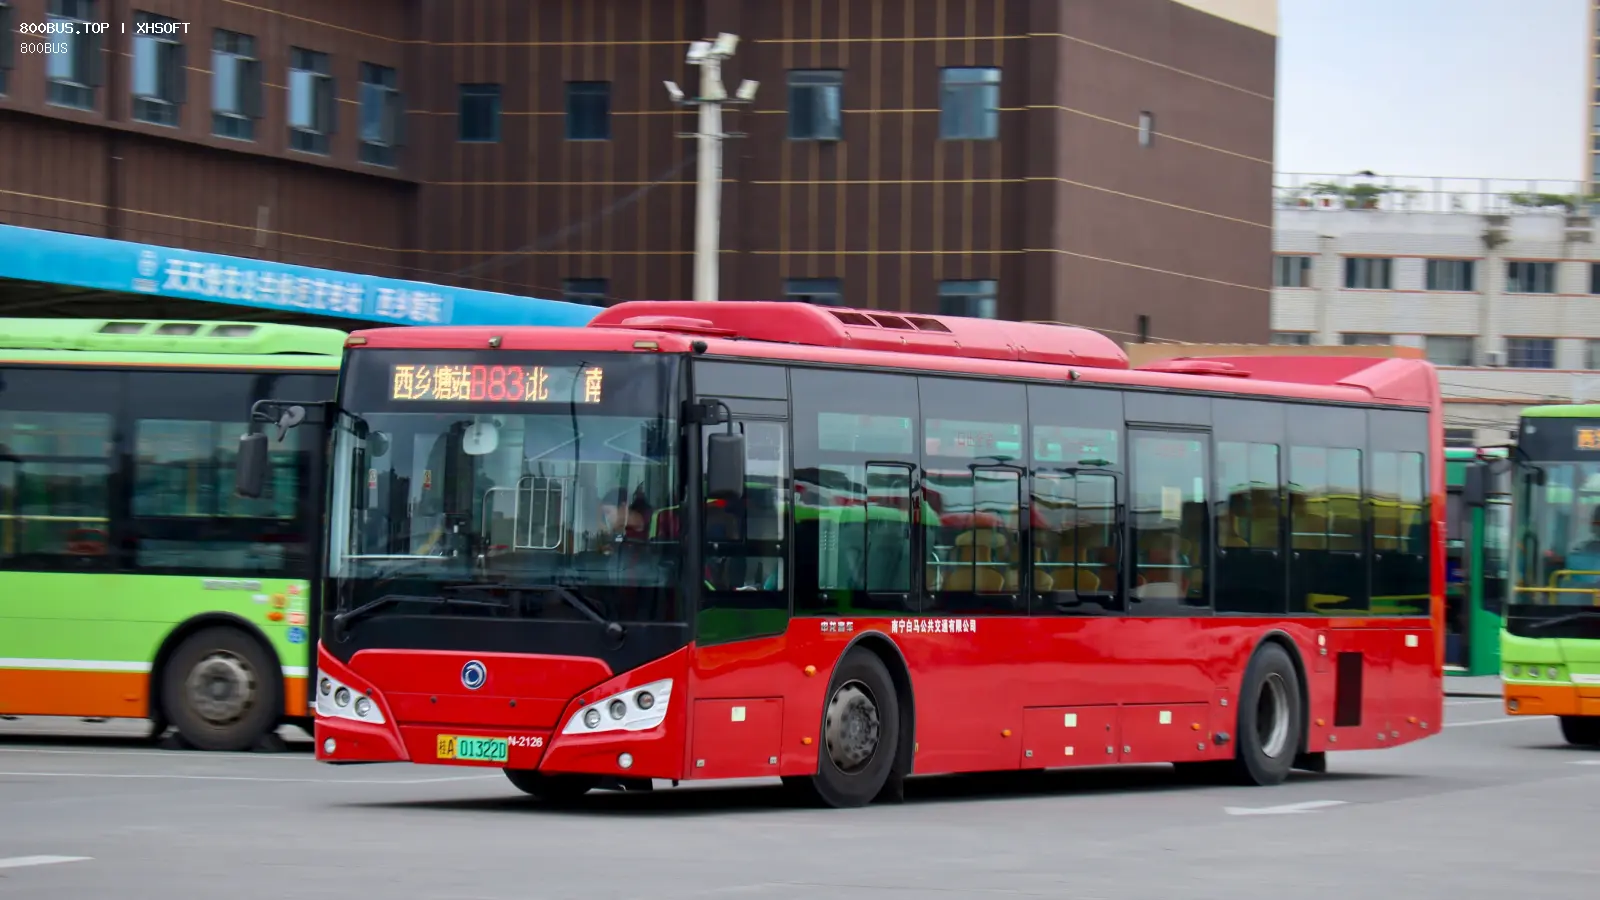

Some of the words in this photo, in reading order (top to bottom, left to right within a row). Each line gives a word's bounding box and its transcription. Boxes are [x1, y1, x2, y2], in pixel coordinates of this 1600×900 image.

[393, 365, 471, 400] 西乡塘站
[891, 618, 977, 634] 南宁白马公共交通有限公司
[507, 735, 544, 748] N-2126
